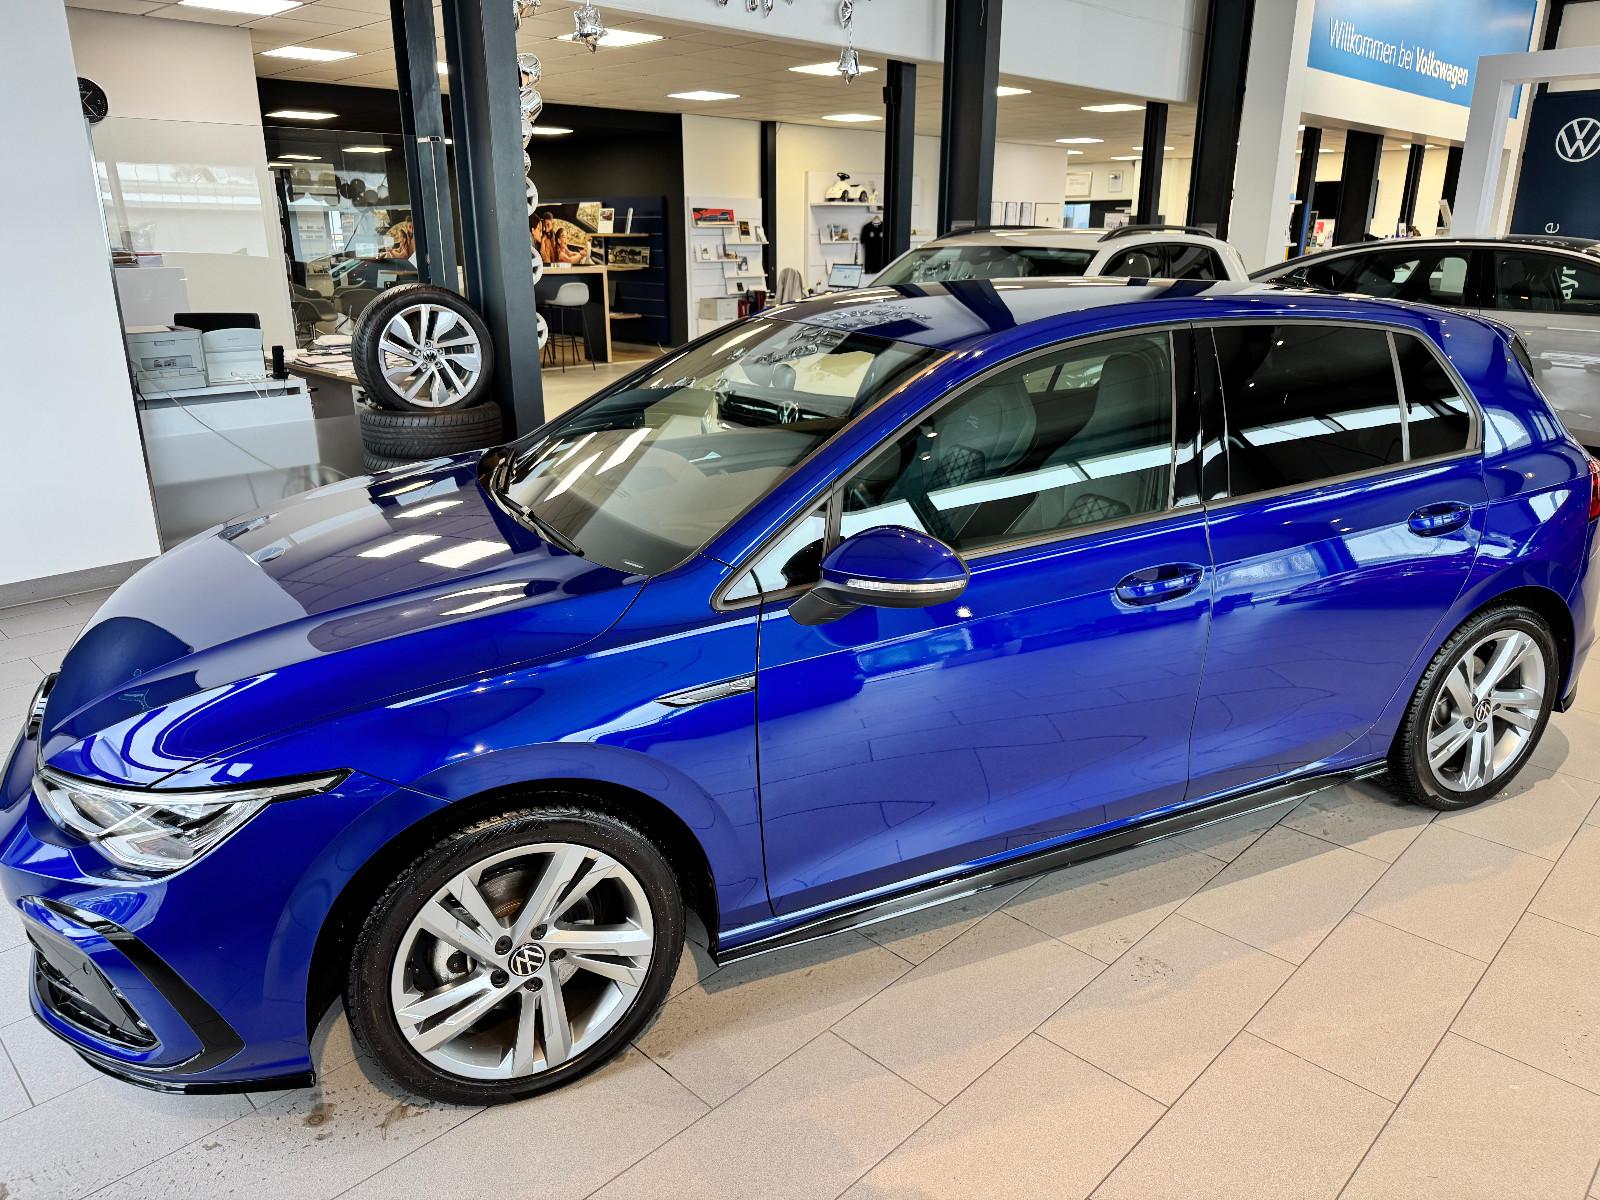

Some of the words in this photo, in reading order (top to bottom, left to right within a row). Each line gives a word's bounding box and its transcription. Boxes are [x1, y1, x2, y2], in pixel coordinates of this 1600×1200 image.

[1329, 17, 1396, 66] Willkommen
[1398, 40, 1415, 71] bei
[1415, 46, 1469, 90] Volkswagen
